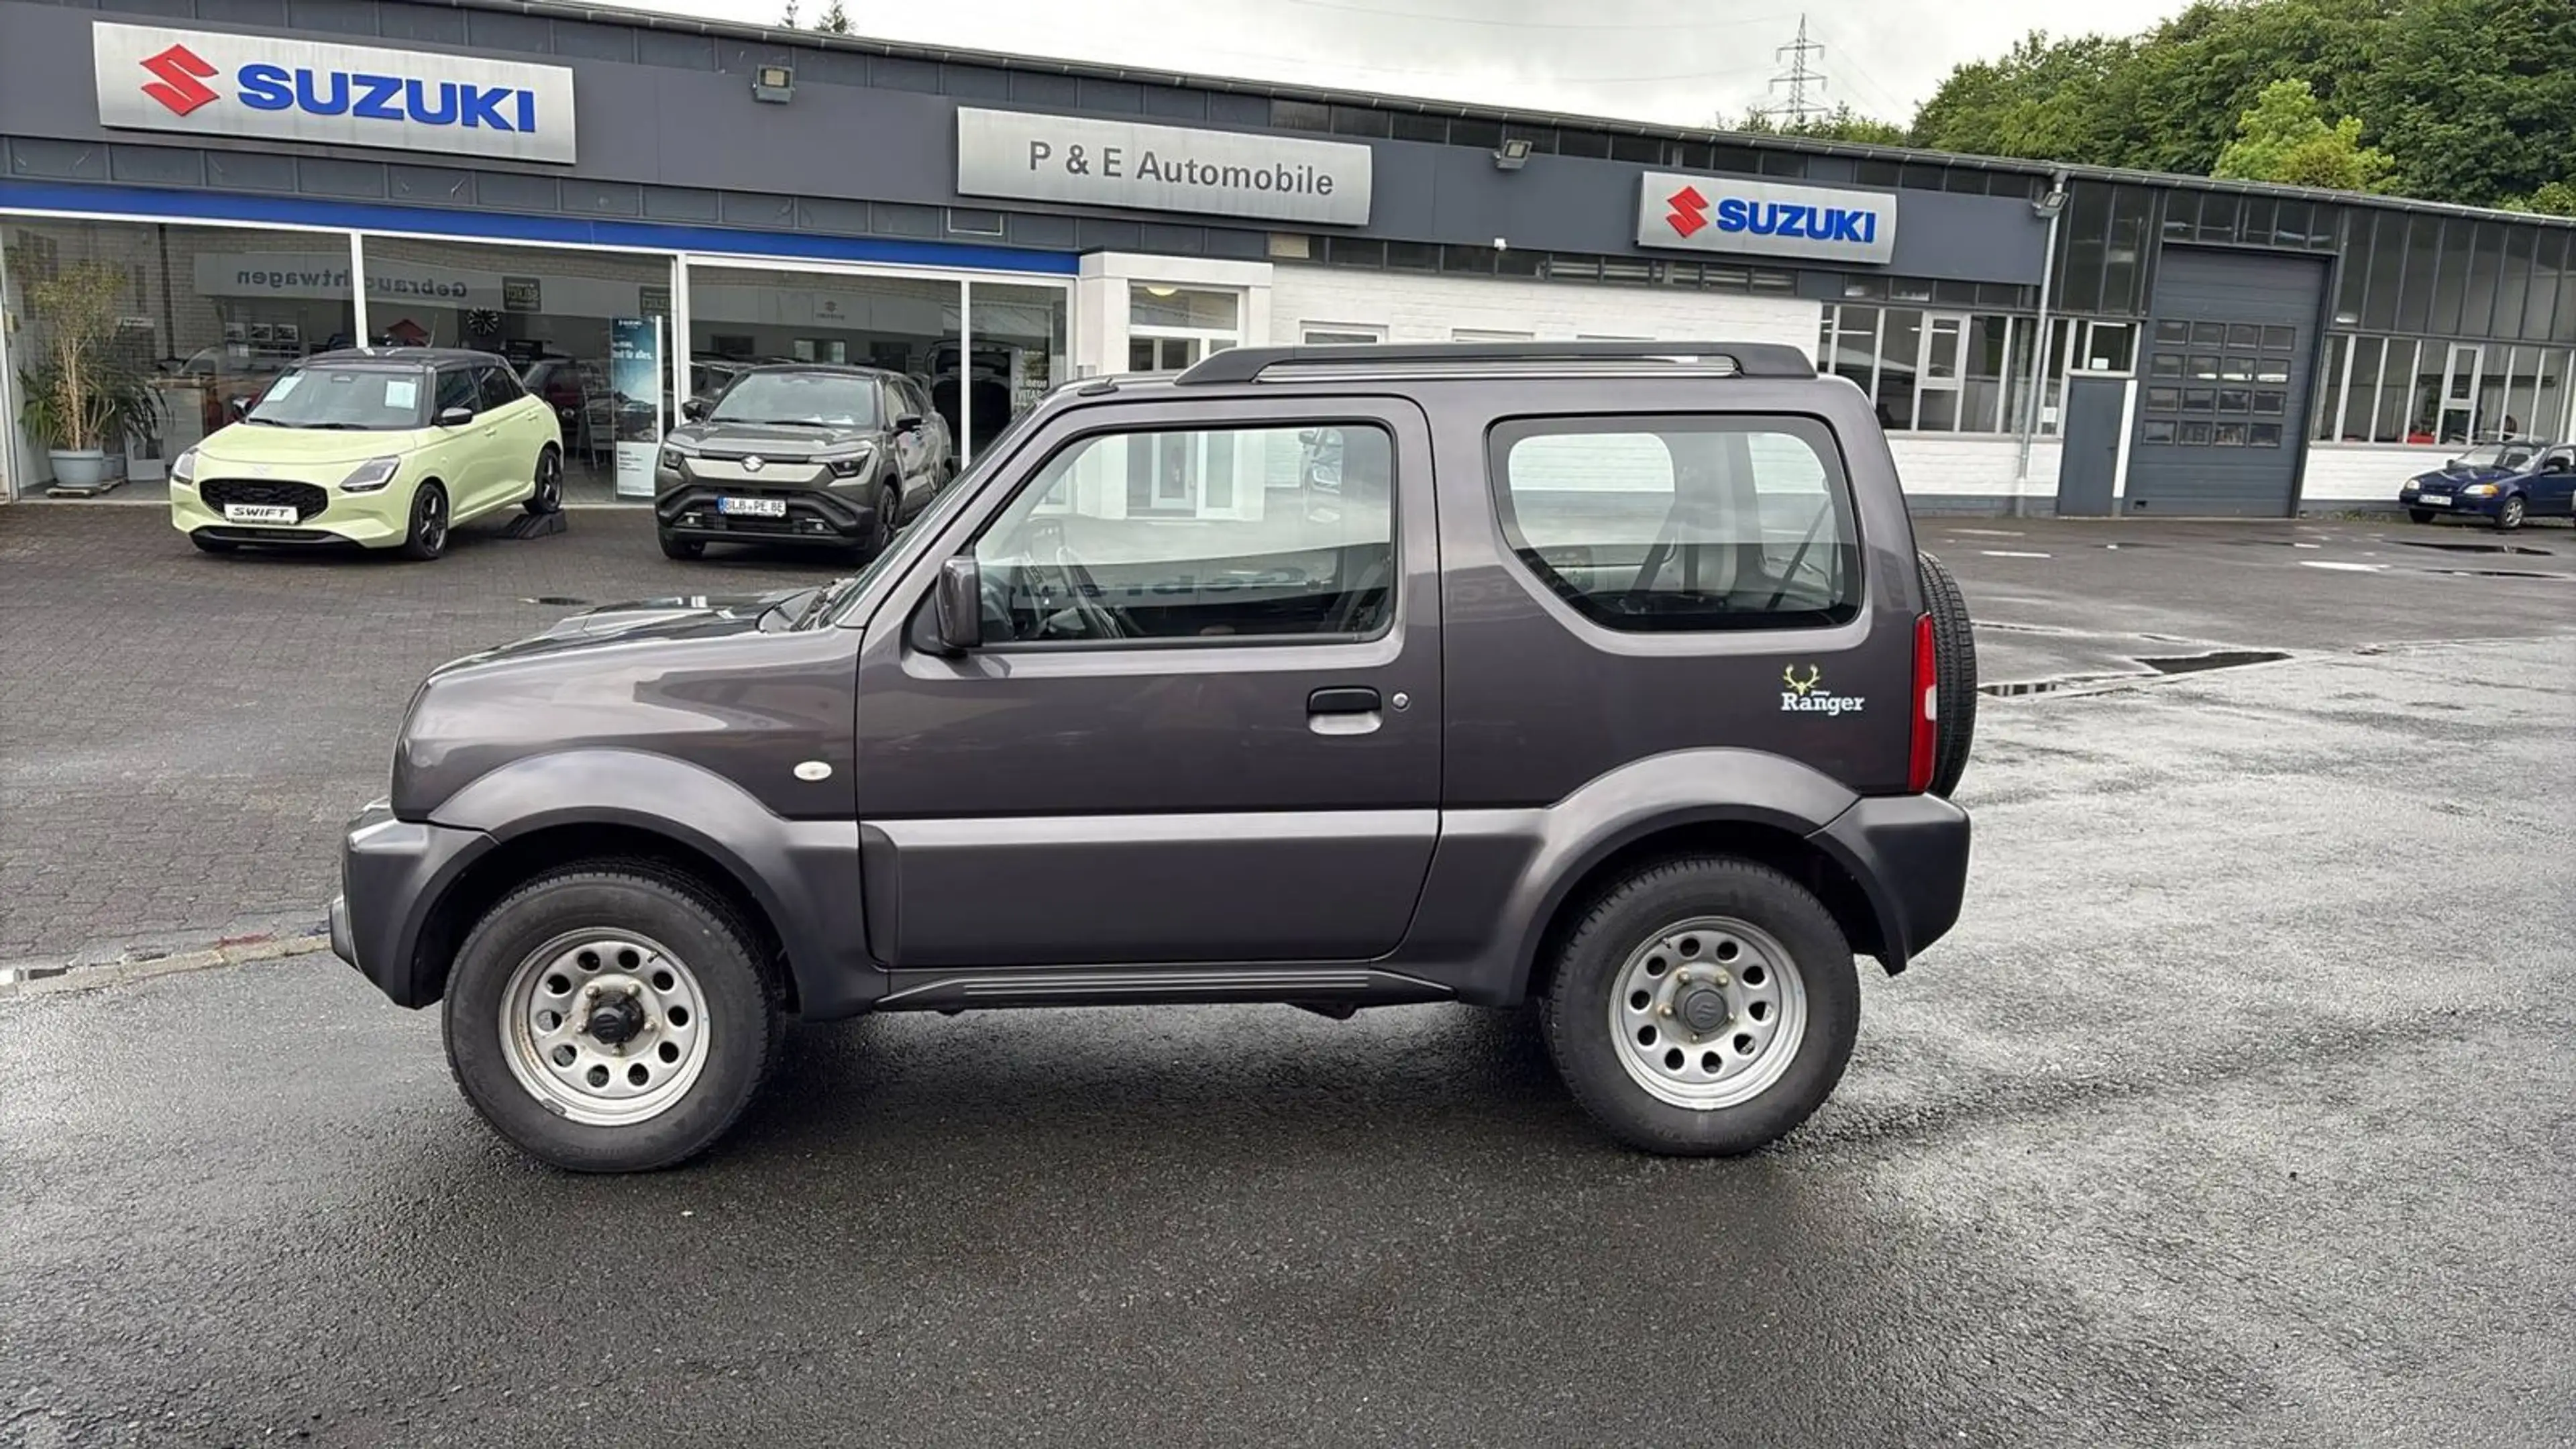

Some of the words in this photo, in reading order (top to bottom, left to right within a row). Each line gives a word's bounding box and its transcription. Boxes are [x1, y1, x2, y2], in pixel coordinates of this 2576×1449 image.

[237, 63, 535, 133] SUZUKI
[1030, 141, 1051, 170] P
[1066, 144, 1090, 175] &
[1104, 147, 1122, 178] E
[1136, 152, 1334, 196] Automobile
[1716, 197, 1878, 245] SUZUKI
[232, 506, 289, 518] SWIFT
[1780, 692, 1865, 716] Ranger
